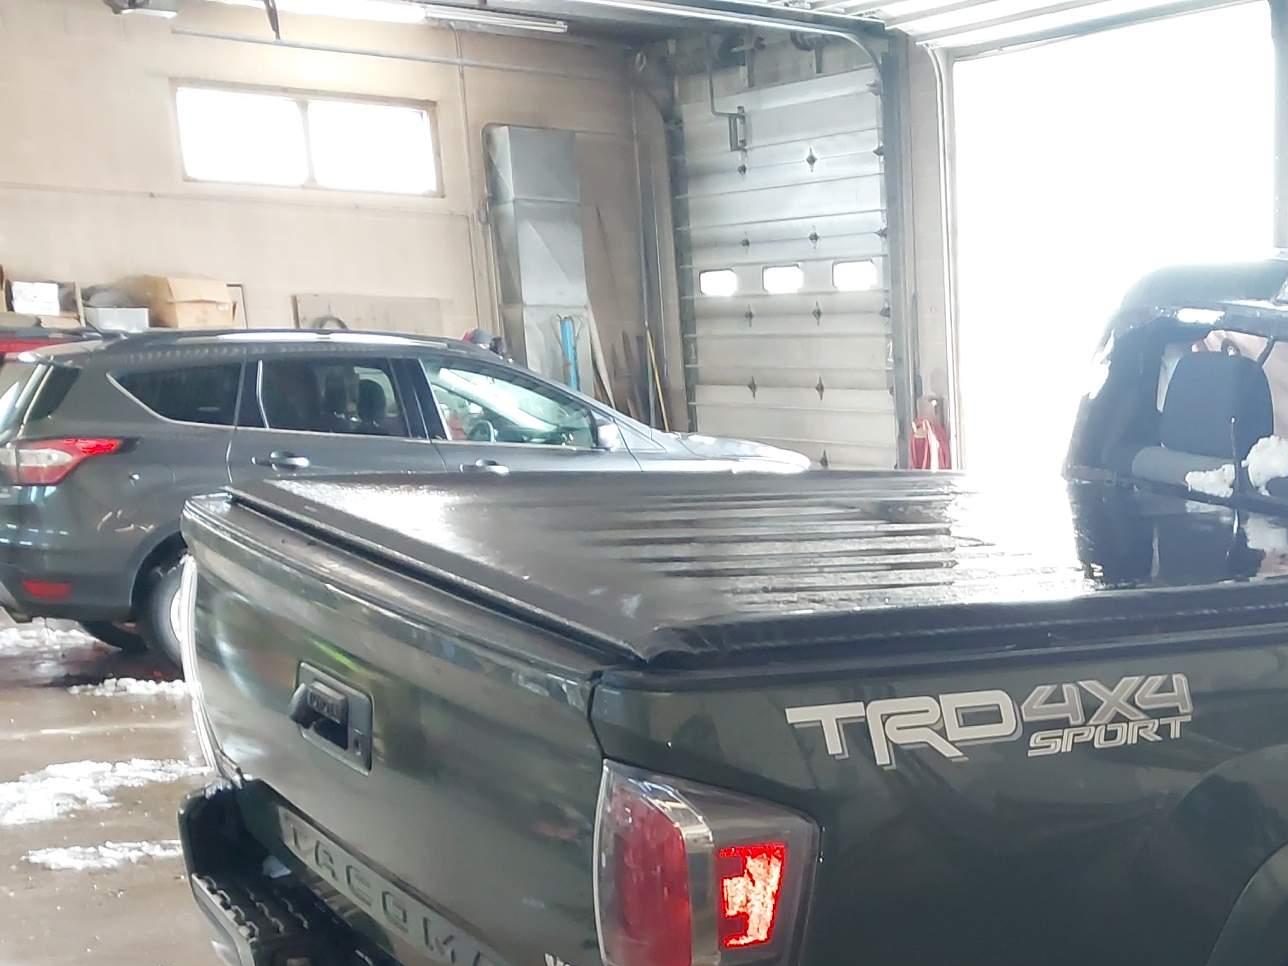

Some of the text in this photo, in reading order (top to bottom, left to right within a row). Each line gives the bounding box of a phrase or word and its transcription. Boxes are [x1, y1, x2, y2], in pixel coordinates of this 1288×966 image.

[785, 673, 1194, 770] TRD 4X4
[1027, 714, 1193, 758] SPORT
